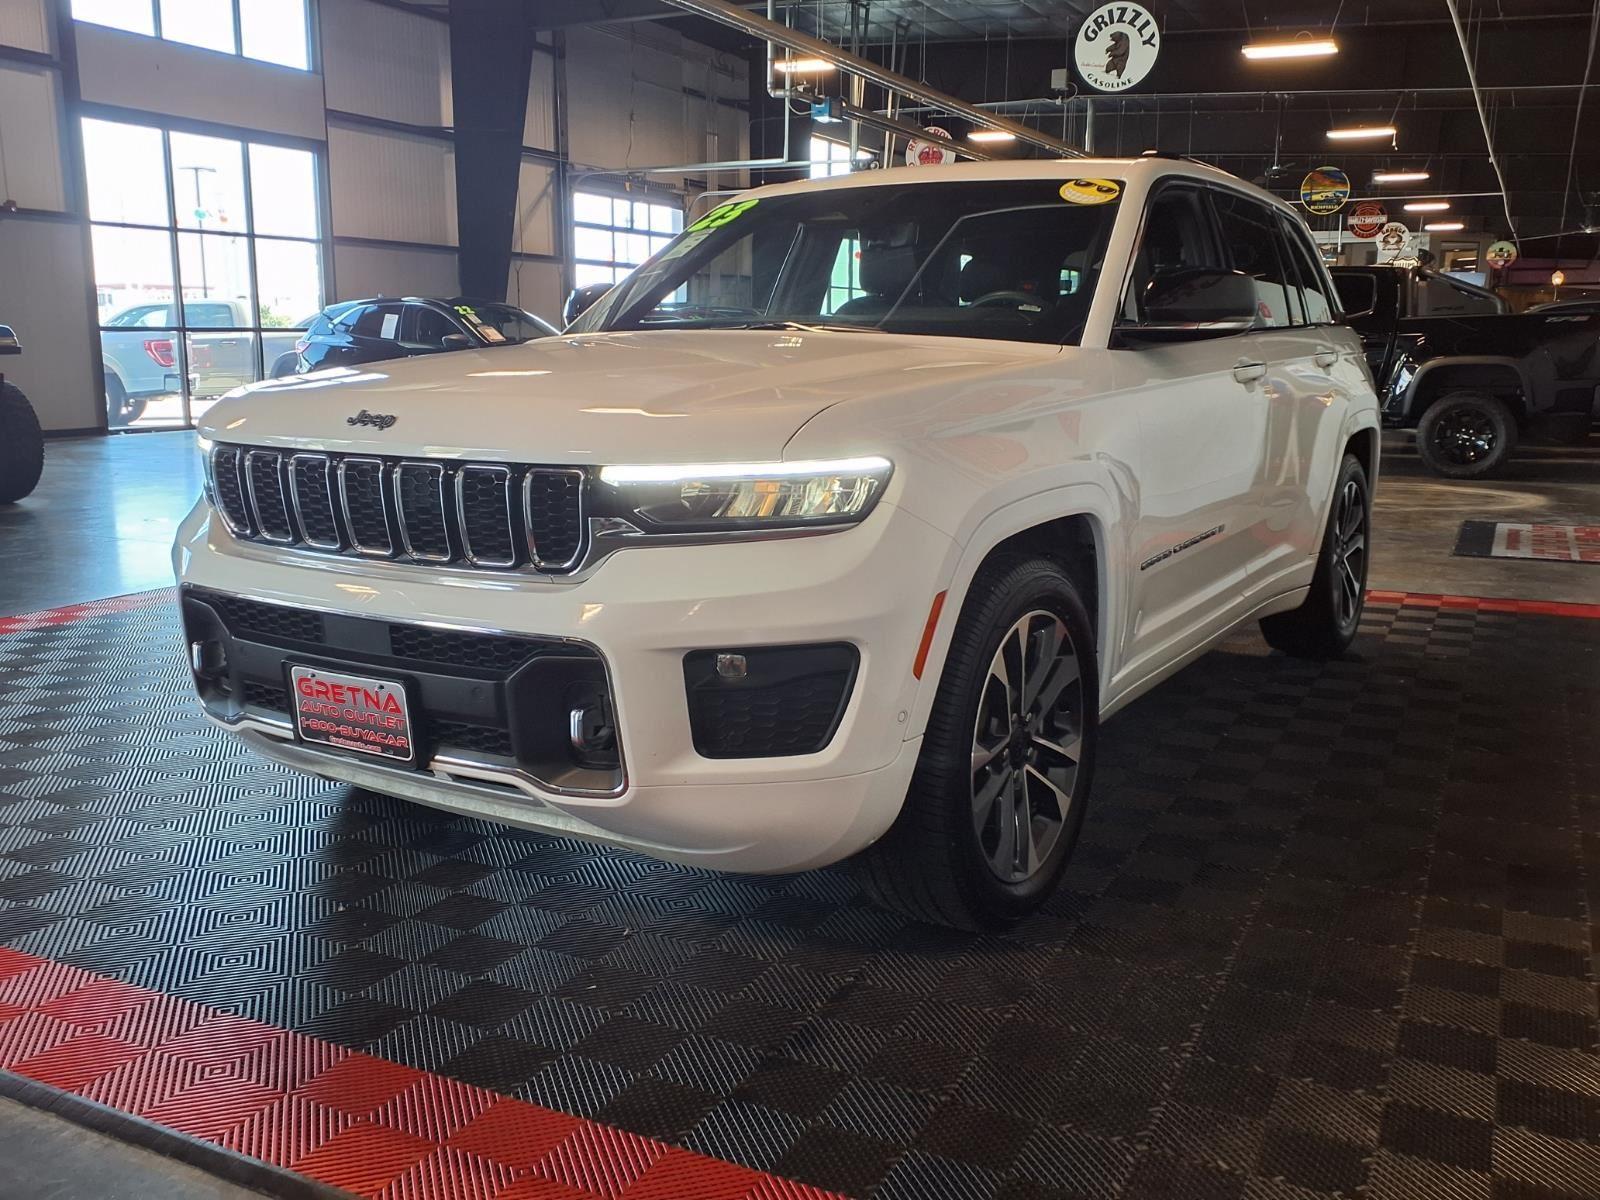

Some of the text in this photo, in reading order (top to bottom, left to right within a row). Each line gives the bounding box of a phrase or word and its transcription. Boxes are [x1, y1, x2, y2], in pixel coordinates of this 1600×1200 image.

[1084, 7, 1156, 48] GRIZZLY
[1087, 73, 1133, 89] GASOLINE
[687, 199, 759, 232] 23
[347, 410, 397, 431] Jeep
[297, 677, 402, 714] GRETNA
[300, 700, 406, 730] AUTO OUTLET
[300, 717, 409, 748] 1-800-BUYACAR
